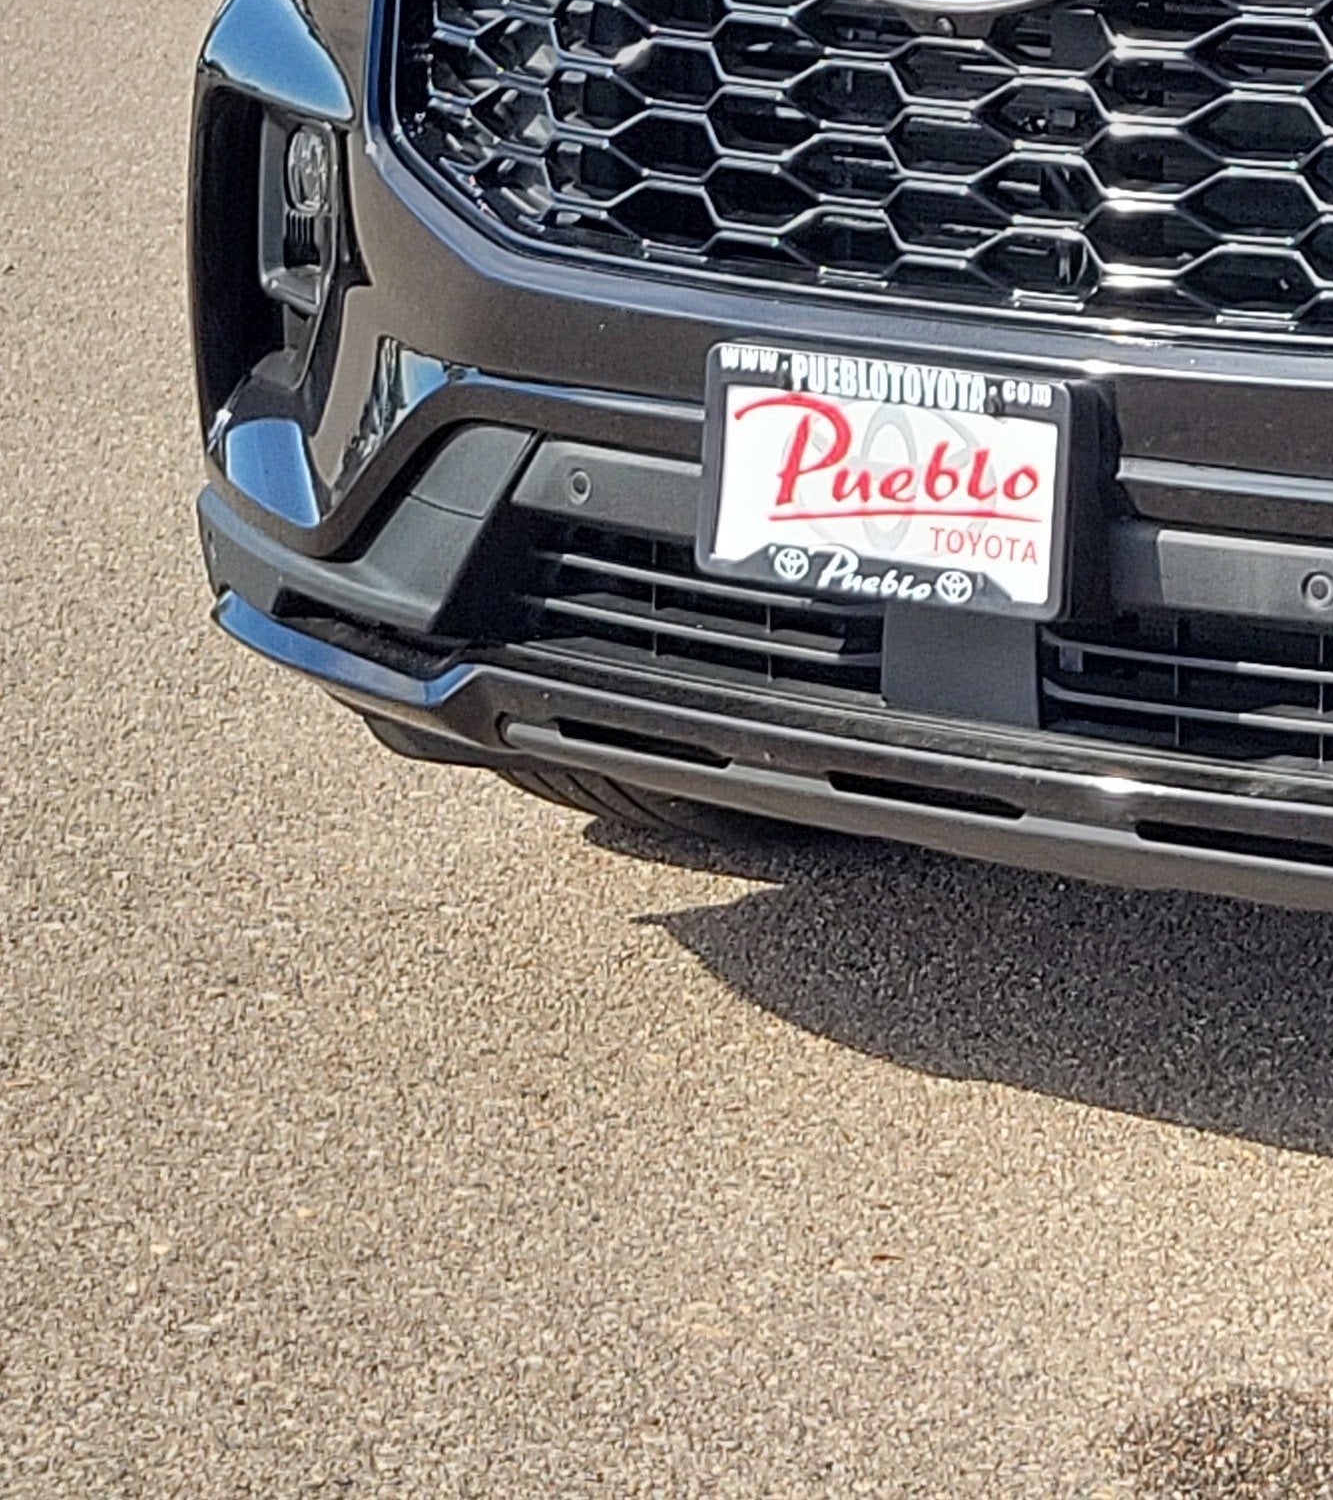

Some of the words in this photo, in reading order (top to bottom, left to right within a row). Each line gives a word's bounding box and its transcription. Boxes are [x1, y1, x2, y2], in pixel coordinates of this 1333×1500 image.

[734, 391, 1039, 506] Pueblo
[808, 543, 933, 601] Pueblo
[929, 526, 1038, 565] TOYOTA
